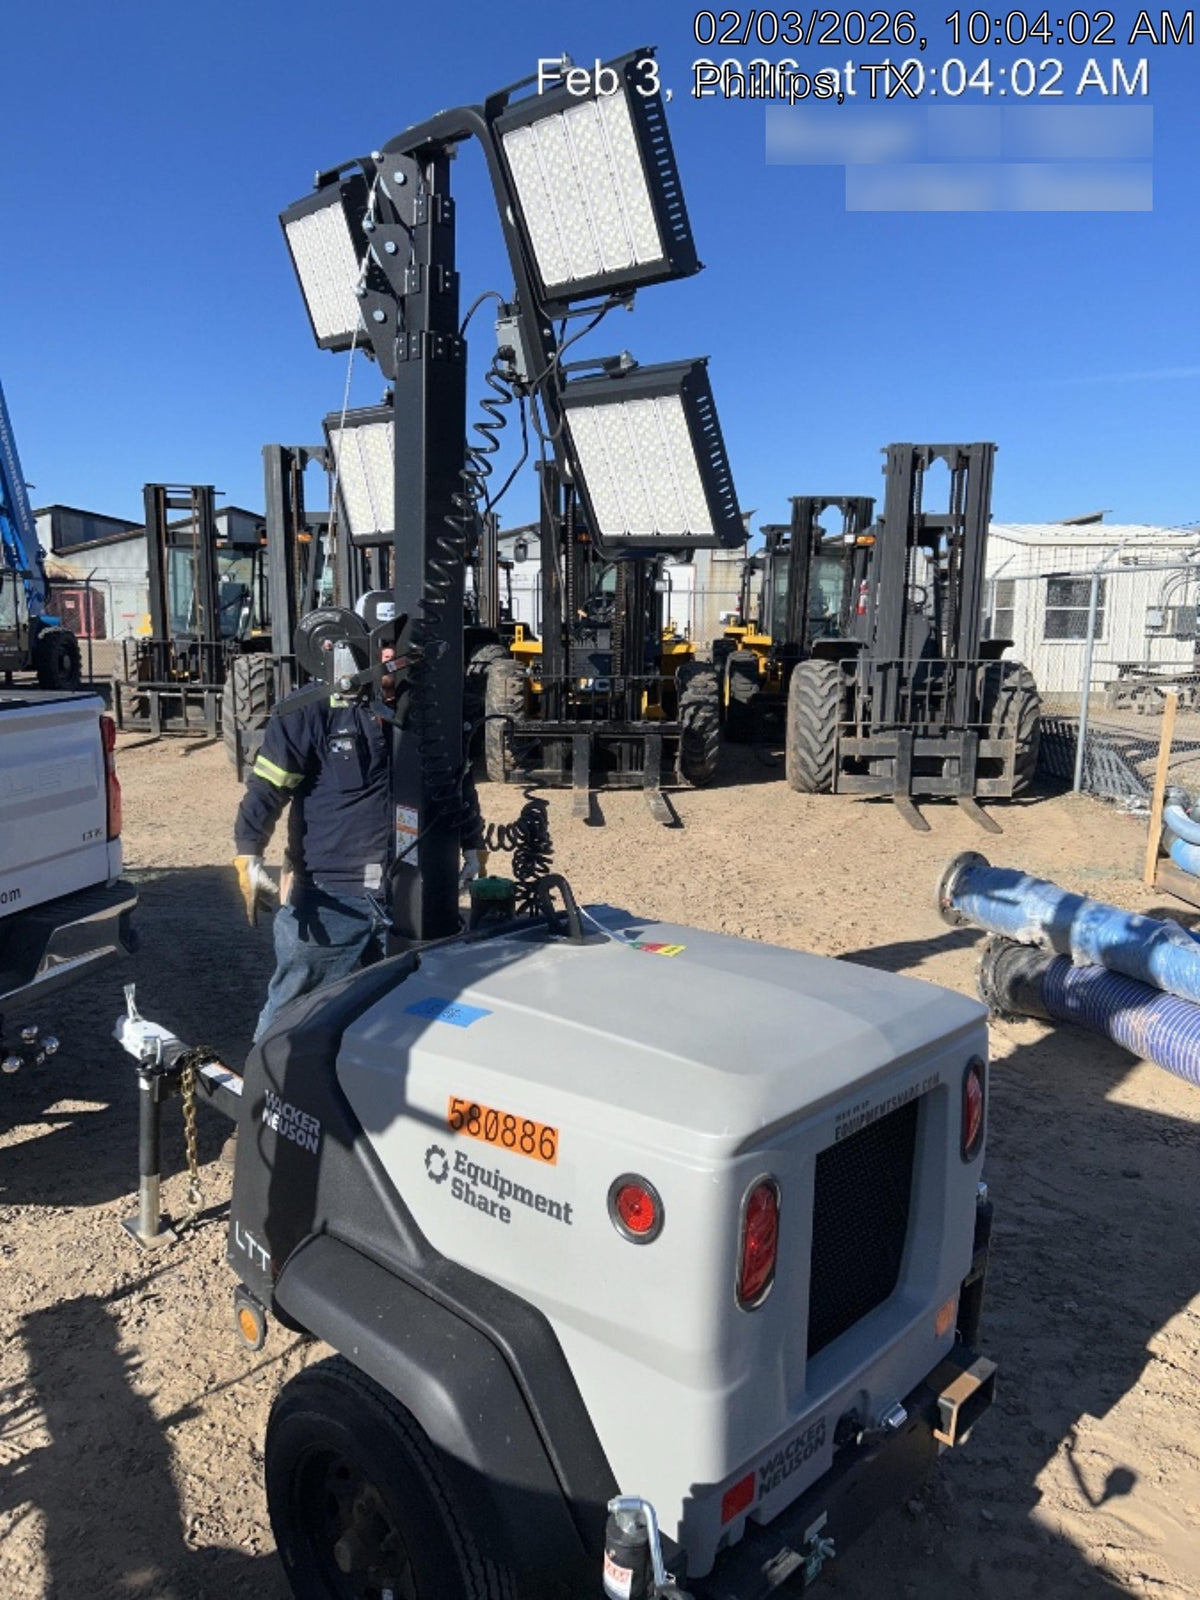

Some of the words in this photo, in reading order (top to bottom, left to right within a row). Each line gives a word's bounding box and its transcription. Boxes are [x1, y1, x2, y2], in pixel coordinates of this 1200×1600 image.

[261, 1106, 320, 1155] NEUSON
[265, 1088, 321, 1137] WACKER
[448, 1098, 557, 1161] 580886
[450, 1176, 512, 1225] Share
[453, 1149, 574, 1226] Equipment
[235, 1220, 272, 1272] LTT
[758, 1415, 827, 1480] WACKER
[758, 1430, 826, 1501] NEUSON
